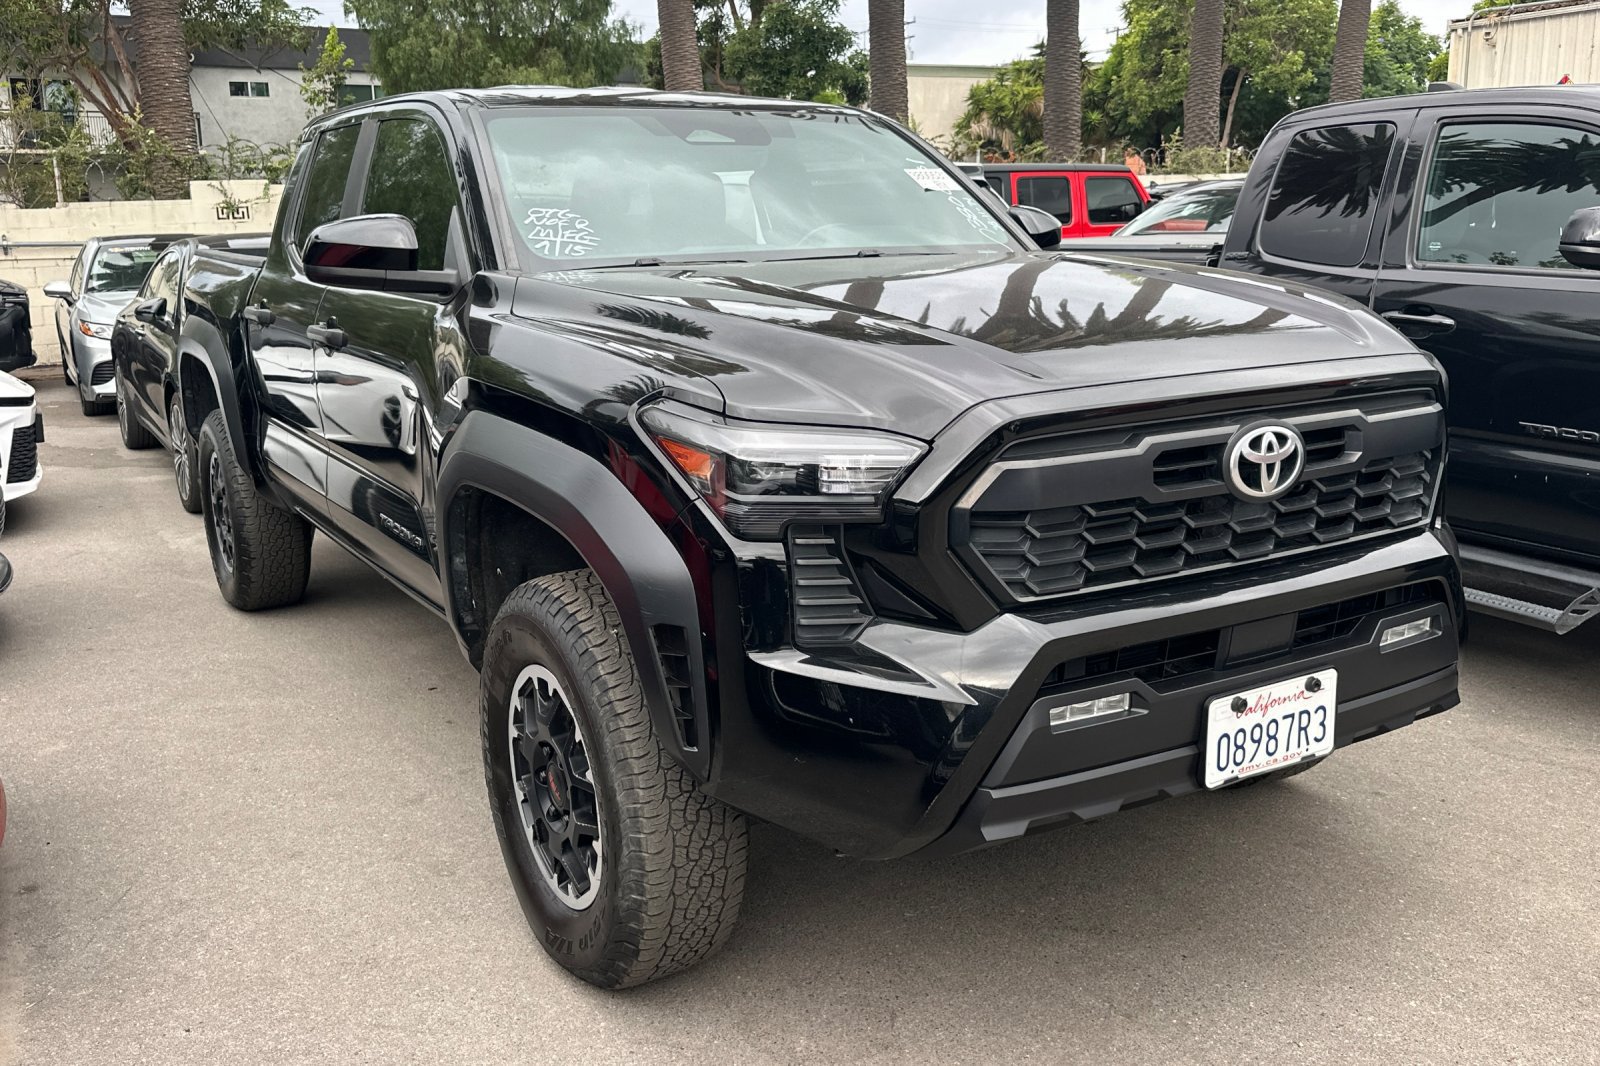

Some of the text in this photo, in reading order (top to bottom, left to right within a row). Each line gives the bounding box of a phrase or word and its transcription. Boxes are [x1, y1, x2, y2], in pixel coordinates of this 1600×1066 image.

[379, 512, 423, 549] TACOMA
[1216, 704, 1327, 772] 08987R3
[1237, 750, 1303, 774] dmv.ca.gov
